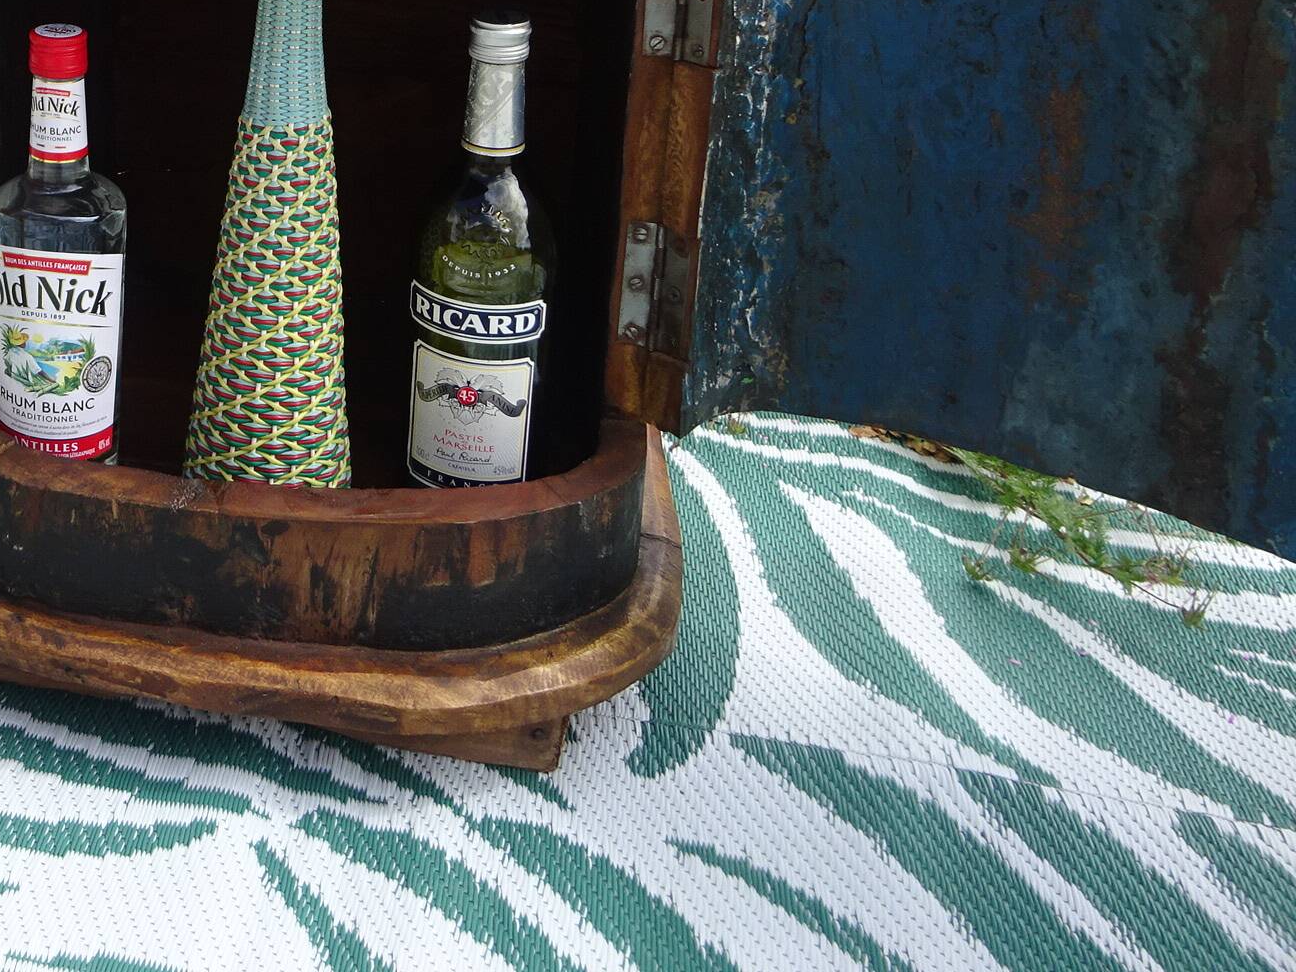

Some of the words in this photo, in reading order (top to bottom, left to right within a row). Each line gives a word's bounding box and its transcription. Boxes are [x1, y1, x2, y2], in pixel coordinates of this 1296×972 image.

[31, 96, 44, 112] Old
[48, 97, 80, 117] Nick
[49, 125, 82, 136] BLANC
[28, 260, 52, 268] ANTILLES
[53, 262, 88, 271] FRANÇAISES
[36, 276, 113, 318] Nick
[21, 310, 48, 319] DEPUIS
[415, 292, 536, 335] RICARD
[0, 385, 36, 412] RHUM
[42, 397, 95, 415] BLANC
[458, 389, 475, 403] 45
[12, 407, 79, 423] TRADITIONNEL
[14, 435, 79, 453] ANTILLES
[433, 434, 495, 453] MARSEILLE
[445, 429, 484, 443] PASTIS
[436, 447, 455, 458] Paul
[458, 451, 492, 463] Ricard
